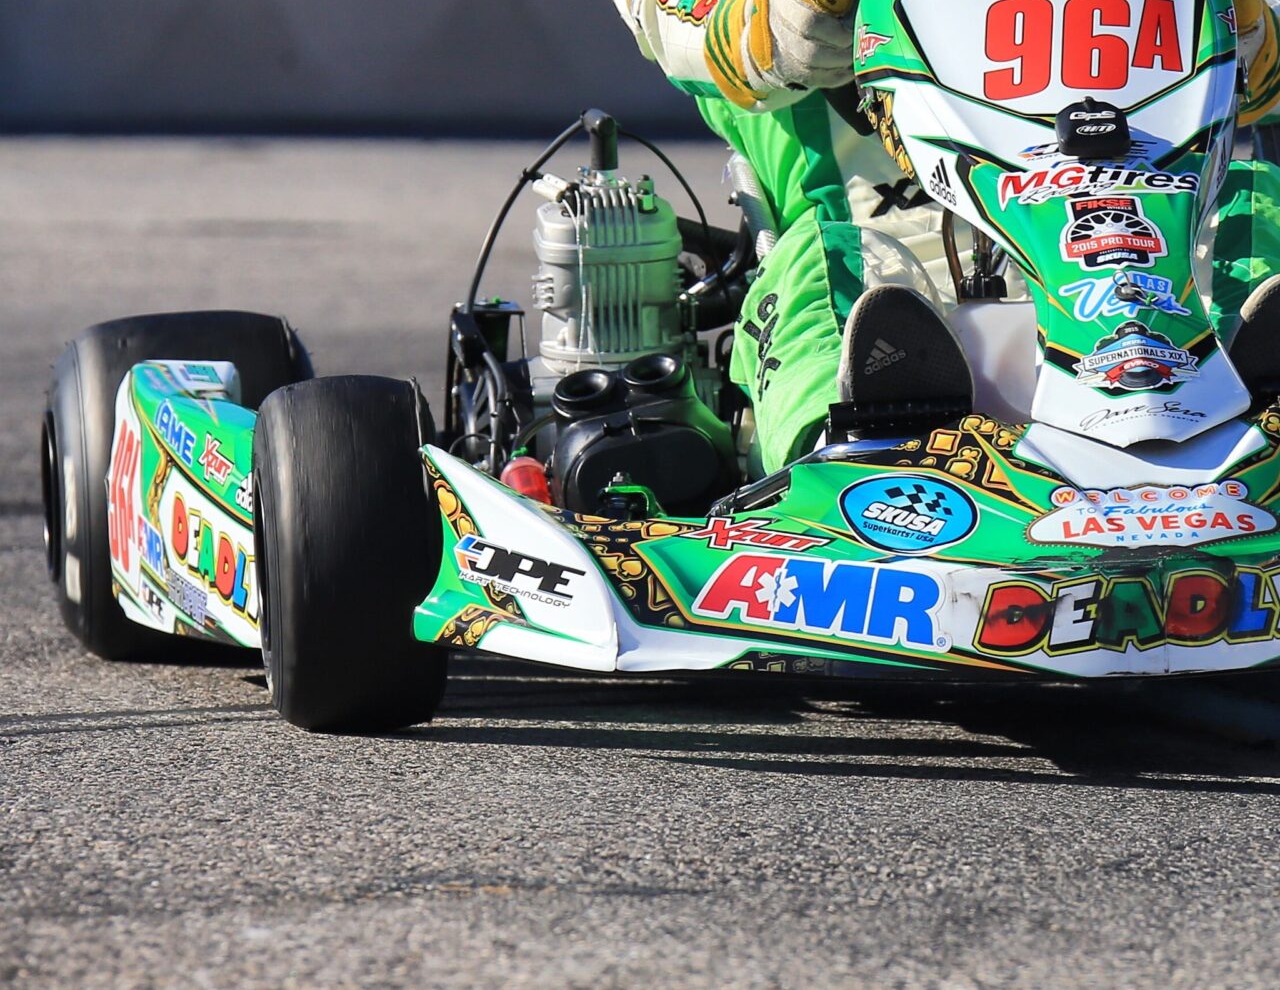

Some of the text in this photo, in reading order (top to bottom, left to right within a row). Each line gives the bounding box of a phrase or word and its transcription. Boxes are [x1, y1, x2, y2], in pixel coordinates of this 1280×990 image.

[929, 180, 957, 206] adidas
[1021, 181, 1115, 203] Racing
[1075, 198, 1132, 211] FIKSE
[1071, 236, 1156, 253] 2015 PRO TOUR
[1096, 252, 1138, 263] SKUSA
[1135, 274, 1166, 291] LAS
[863, 349, 906, 375] adidas
[1088, 348, 1184, 367] SUPERNATIONALS XIX
[155, 399, 196, 468] AME
[1054, 484, 1243, 504] WELCOME
[862, 501, 947, 536] SKUSA
[1077, 503, 1215, 517] TO Fabulous
[863, 521, 935, 543] Superkarts! USA
[1063, 512, 1257, 539] LAS VEGAS
[1116, 531, 1200, 543] NEVADA
[460, 570, 571, 609] KART TECHNOLOGY
